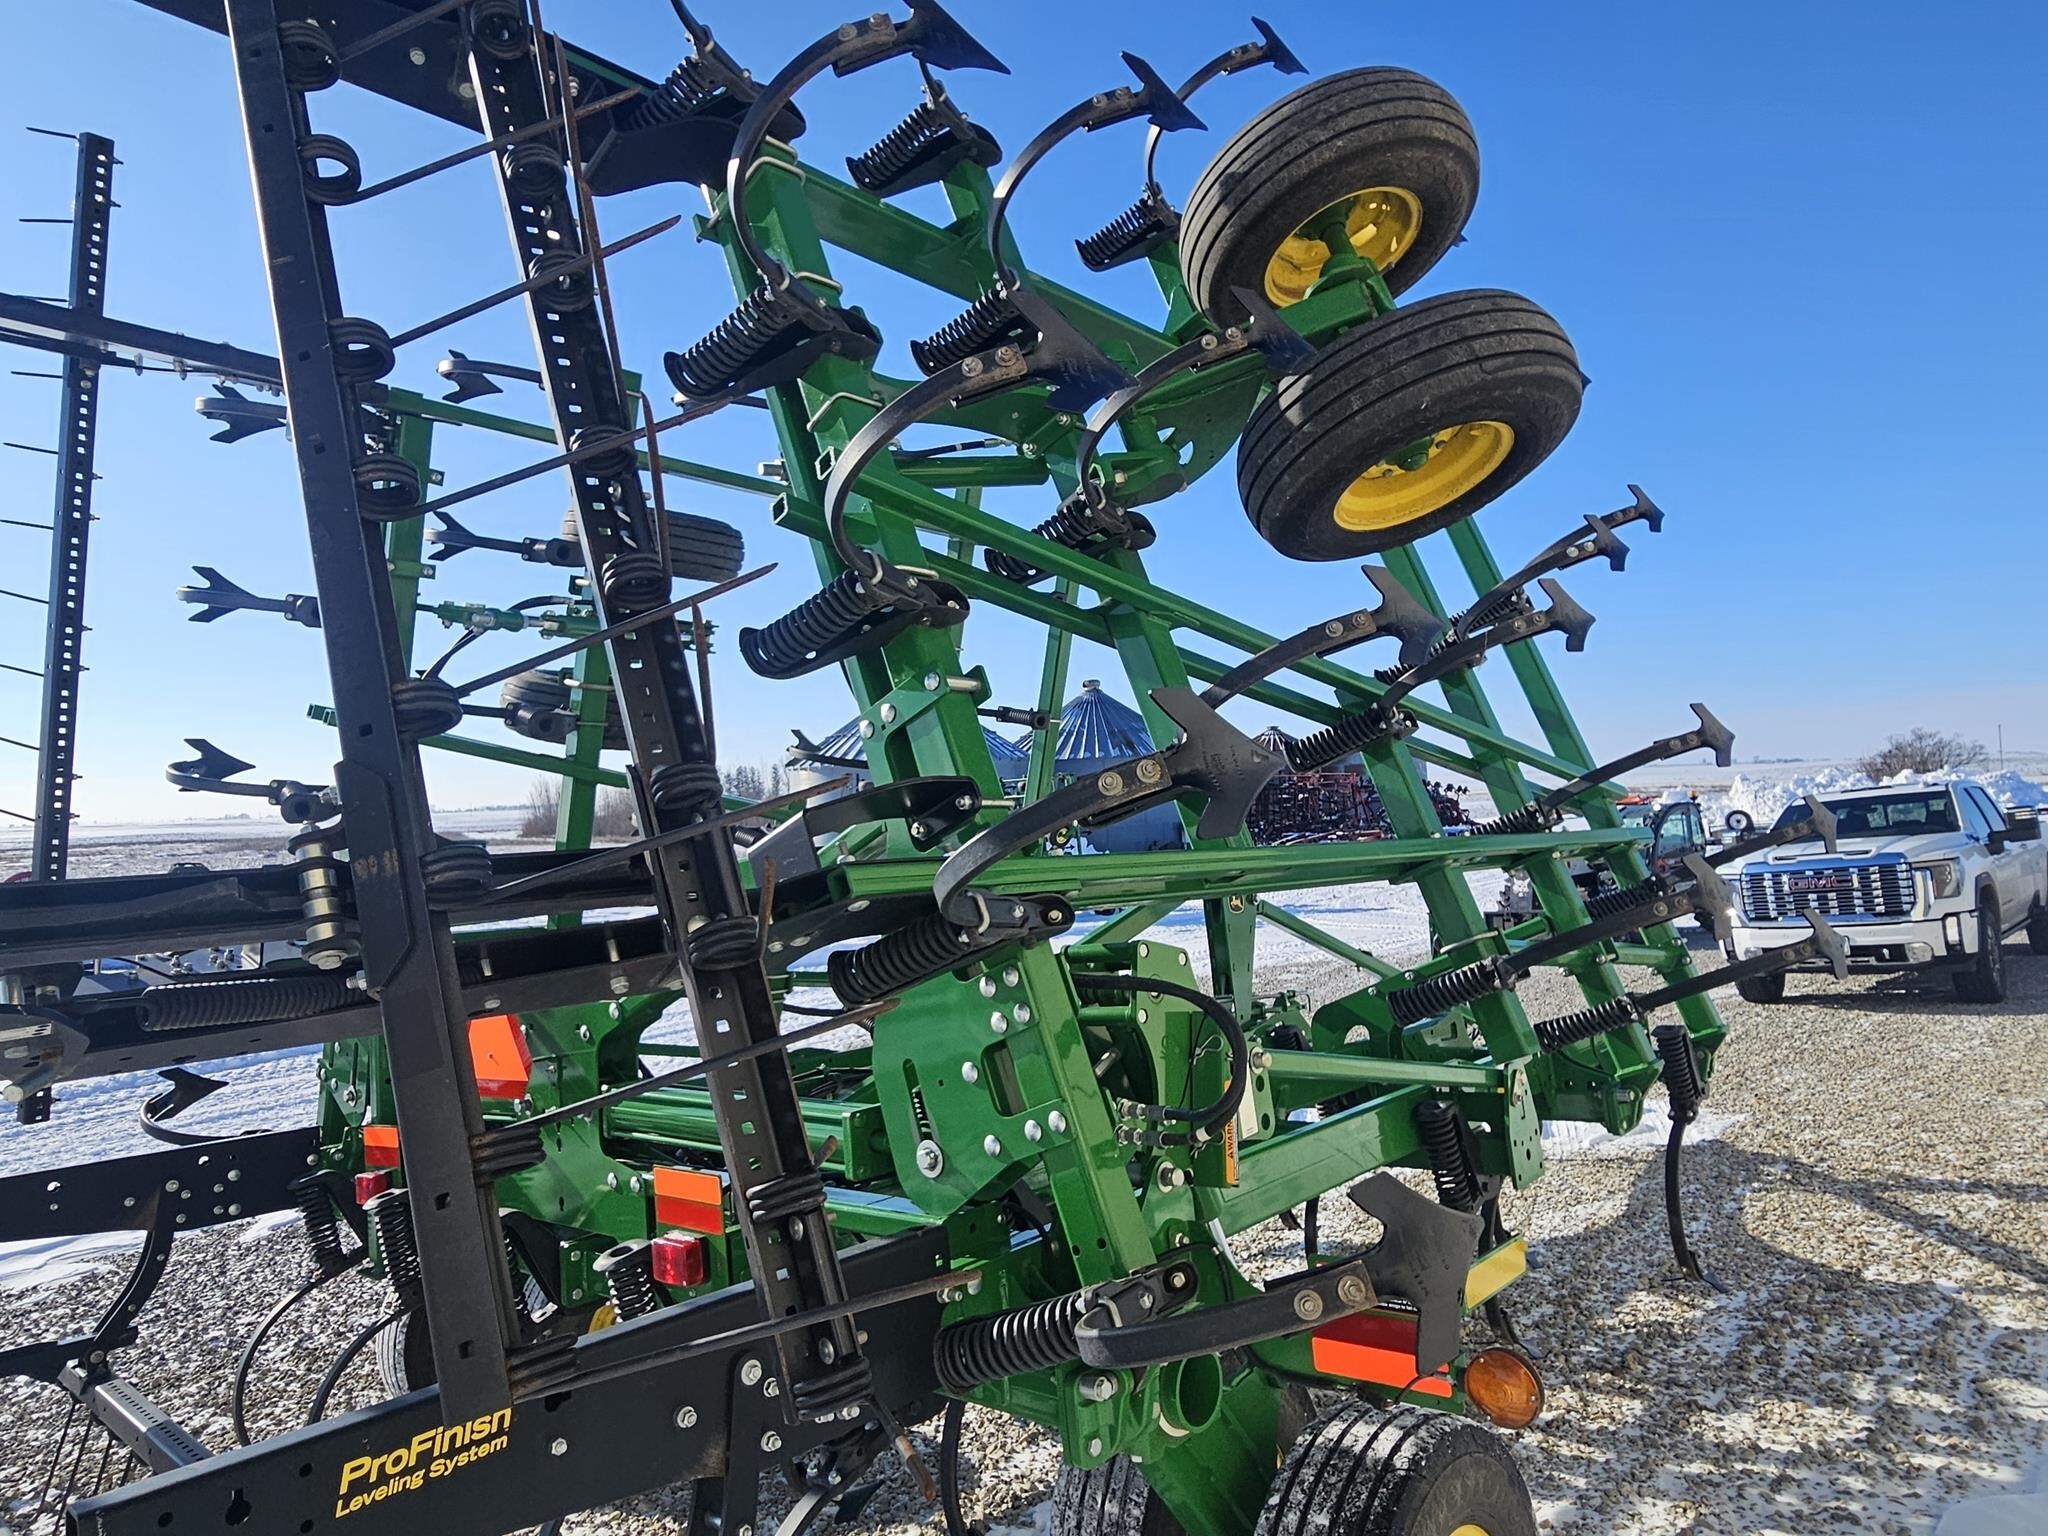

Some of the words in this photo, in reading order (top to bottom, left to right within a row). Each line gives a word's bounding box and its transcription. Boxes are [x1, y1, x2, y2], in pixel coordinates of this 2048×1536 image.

[1789, 875, 1852, 890] GMC
[335, 1469, 425, 1519] Leveling
[429, 1435, 508, 1479] System
